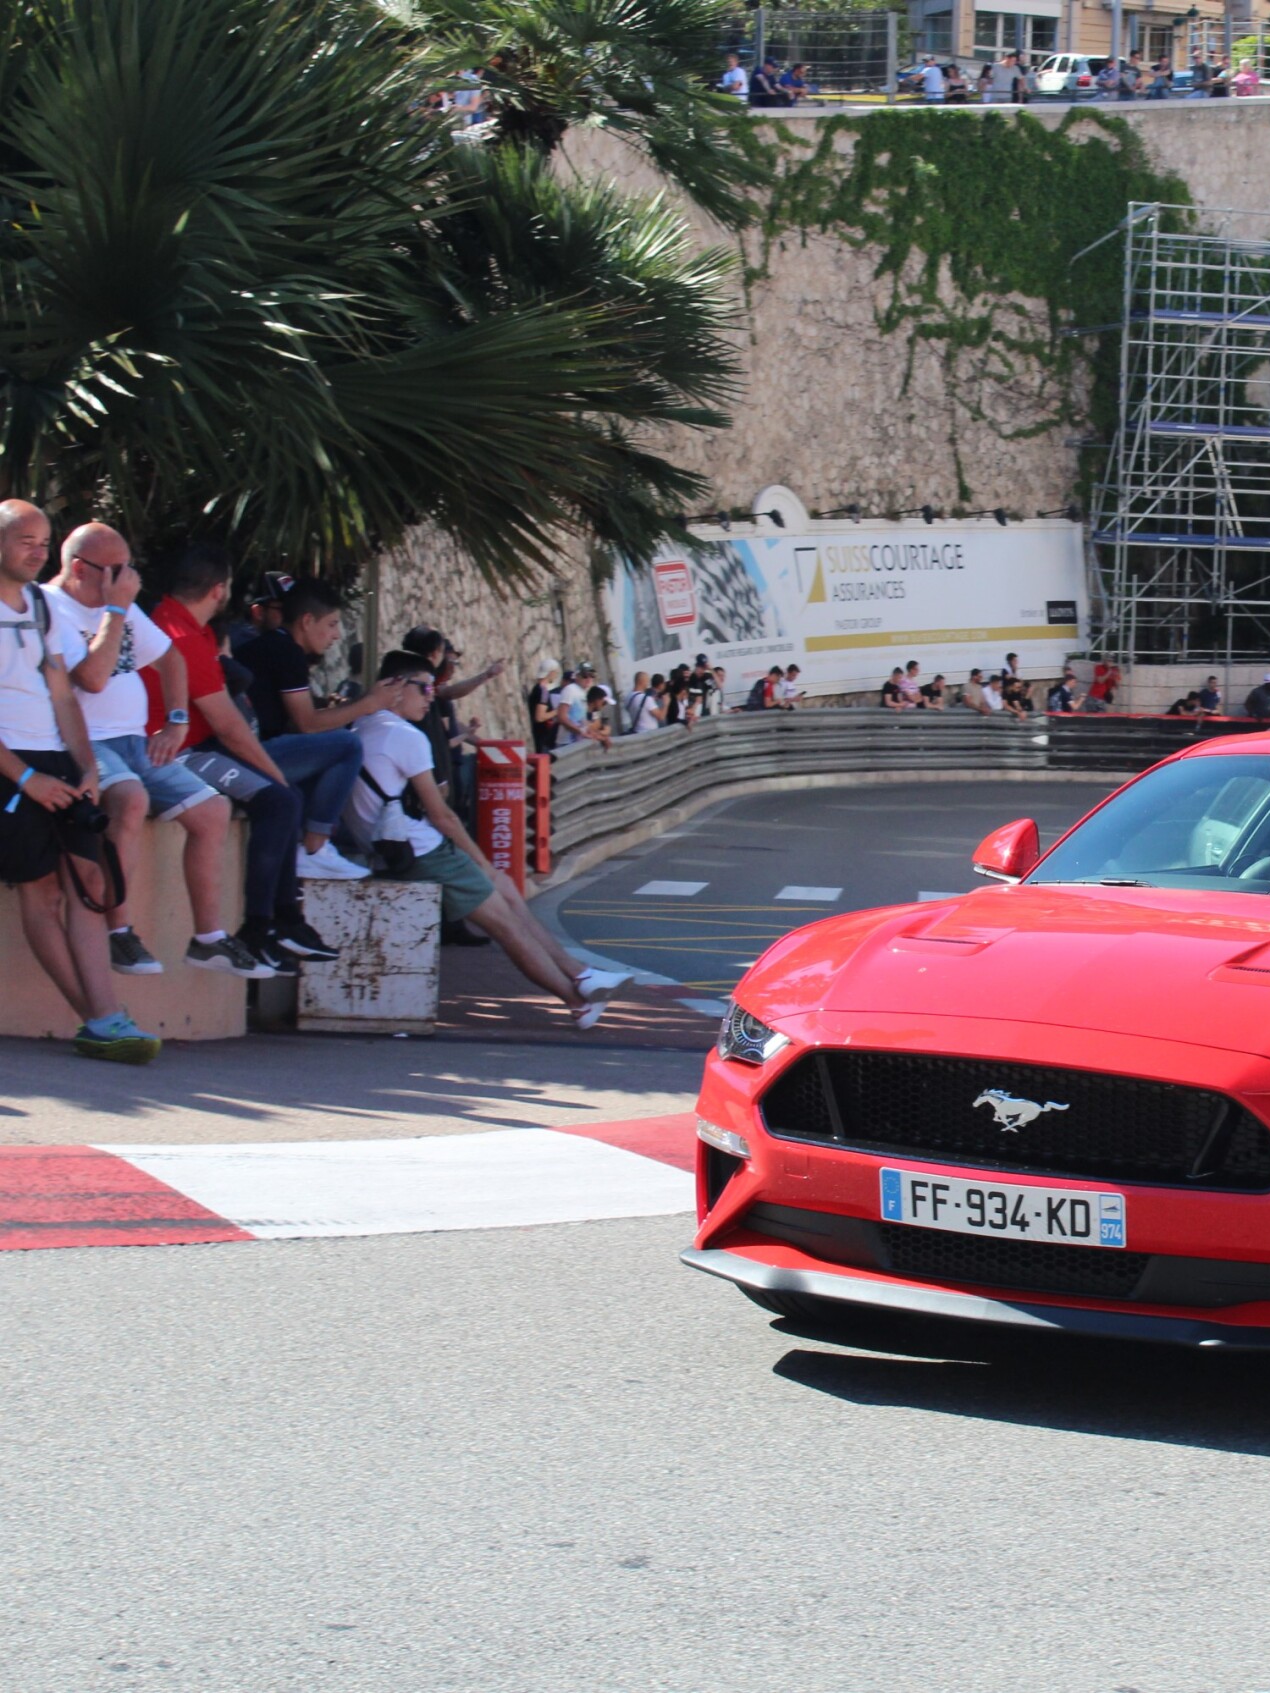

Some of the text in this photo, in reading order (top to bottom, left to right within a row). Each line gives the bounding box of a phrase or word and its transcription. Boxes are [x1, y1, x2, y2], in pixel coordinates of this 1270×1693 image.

[825, 543, 966, 573] SUISSCOURTAGE
[832, 580, 906, 602] ASSURANCES
[491, 808, 513, 849] GRAND
[888, 1179, 1122, 1241] F FF-934-KD 974
